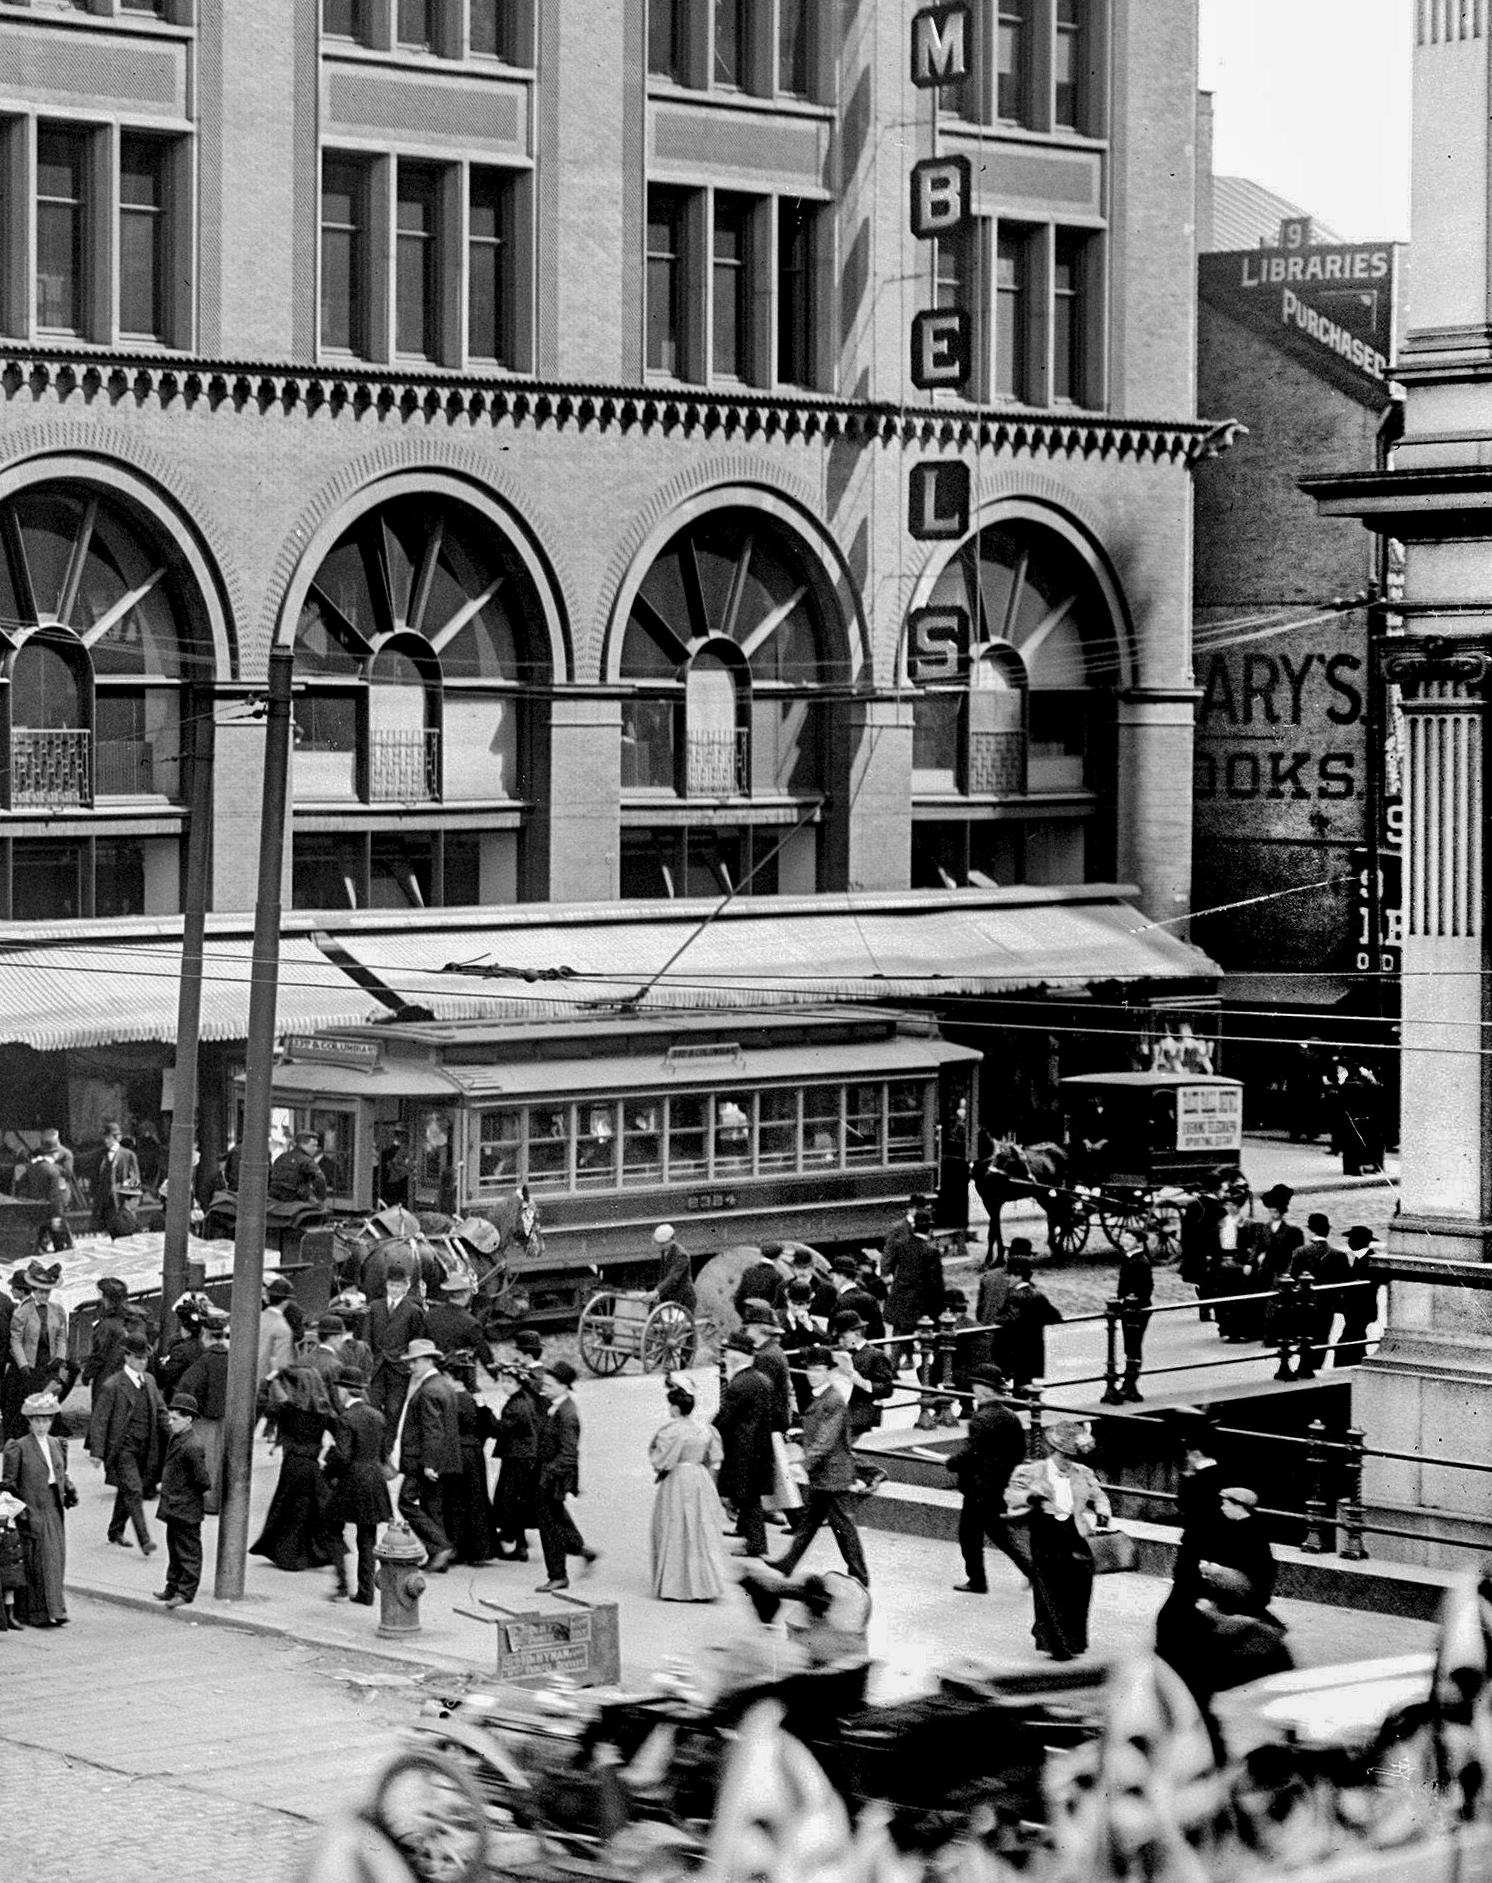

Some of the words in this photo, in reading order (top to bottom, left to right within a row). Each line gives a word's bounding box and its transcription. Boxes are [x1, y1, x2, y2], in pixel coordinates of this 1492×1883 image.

[1287, 223, 1302, 249] 9
[1242, 252, 1388, 287] LIBRARIES
[1282, 287, 1387, 380] PURCHASED
[1193, 653, 1367, 726] ARY'S.
